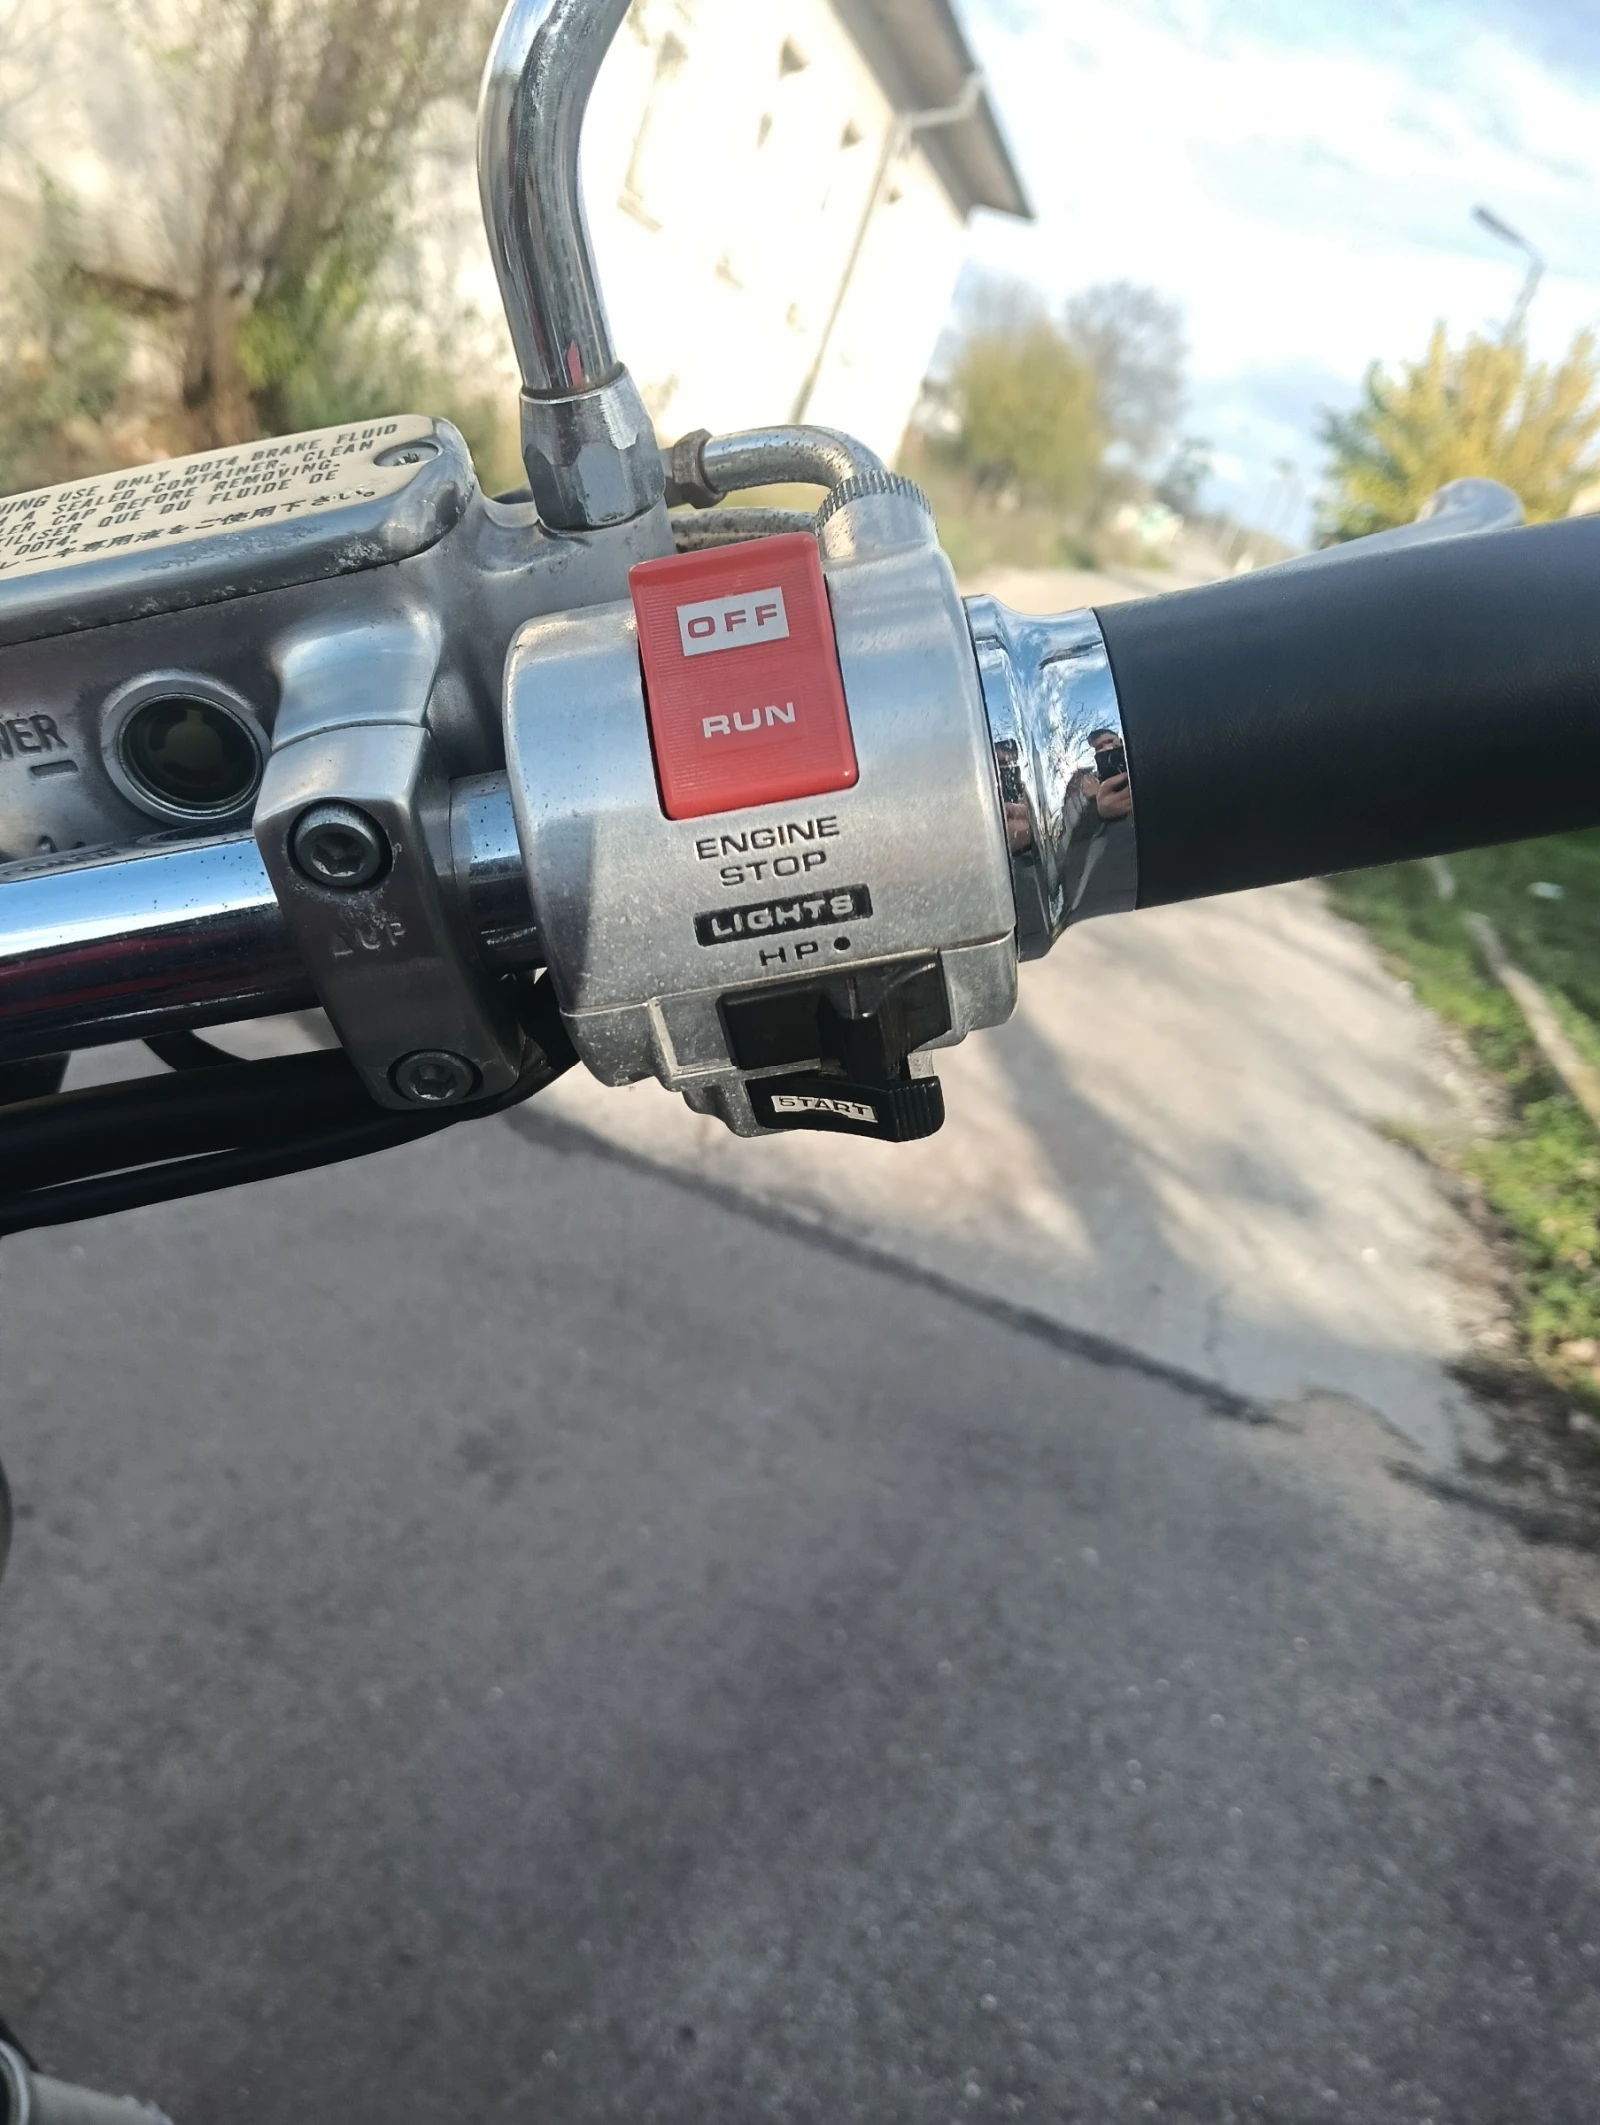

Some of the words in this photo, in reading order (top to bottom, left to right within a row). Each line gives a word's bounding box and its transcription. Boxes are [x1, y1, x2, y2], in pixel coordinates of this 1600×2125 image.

[21, 510, 36, 521] A
[52, 489, 136, 515] SEALED
[152, 460, 287, 494] CONTAINER.
[302, 440, 374, 462] CLEAN
[58, 485, 101, 502] USE
[115, 470, 170, 491] ONLY
[185, 456, 239, 475] DOT4
[251, 439, 322, 461] BRAKE
[336, 423, 398, 444] FLUID
[52, 508, 97, 526] CAP
[112, 487, 198, 514] BEFORE
[213, 459, 341, 492] REMOVING.
[98, 509, 145, 528] QUE
[160, 500, 192, 515] DU
[208, 479, 292, 505] FLUIDE
[309, 469, 340, 484] DE
[14, 535, 78, 556] DOT4.
[688, 604, 778, 639] OFF
[702, 702, 796, 738] RUN
[695, 815, 840, 861] ENGINE
[719, 850, 827, 887] STOP
[711, 894, 854, 937] LIGHTS
[779, 1096, 869, 1116] START
